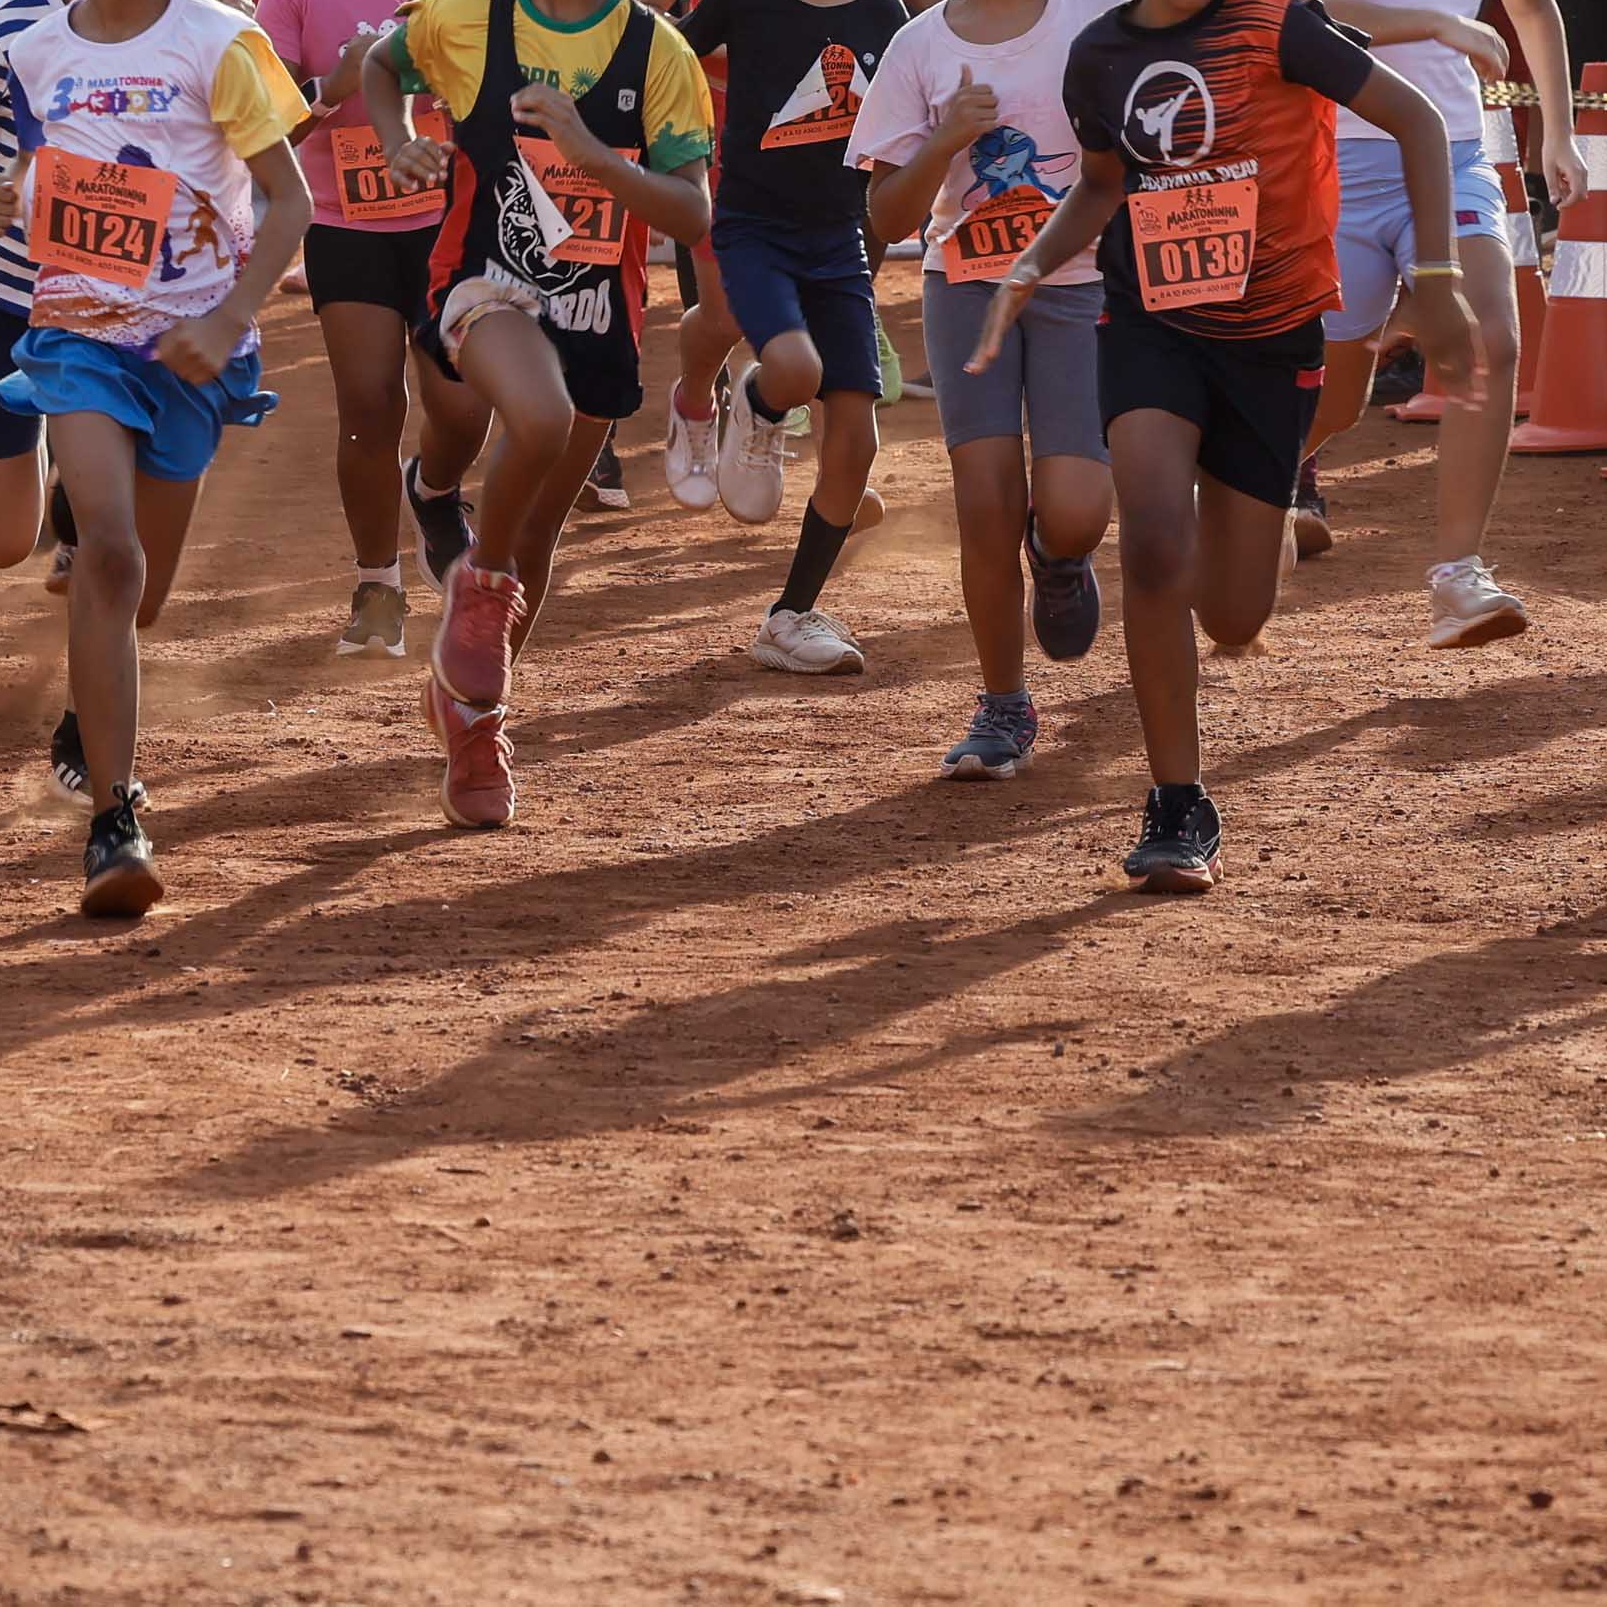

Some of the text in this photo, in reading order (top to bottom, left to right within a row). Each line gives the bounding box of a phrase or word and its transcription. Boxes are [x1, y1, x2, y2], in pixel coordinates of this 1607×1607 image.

[542, 163, 596, 184] MARATO
[1166, 205, 1240, 231] MARATONINHA
[1188, 221, 1206, 230] LAGO
[1206, 219, 1229, 228] NORTE
[61, 204, 145, 261] 0124
[581, 244, 615, 256] METROS
[1159, 233, 1245, 283] 0138
[1181, 288, 1202, 298] ANOS
[1206, 285, 1220, 294] 400
[1220, 281, 1244, 292] METRO
